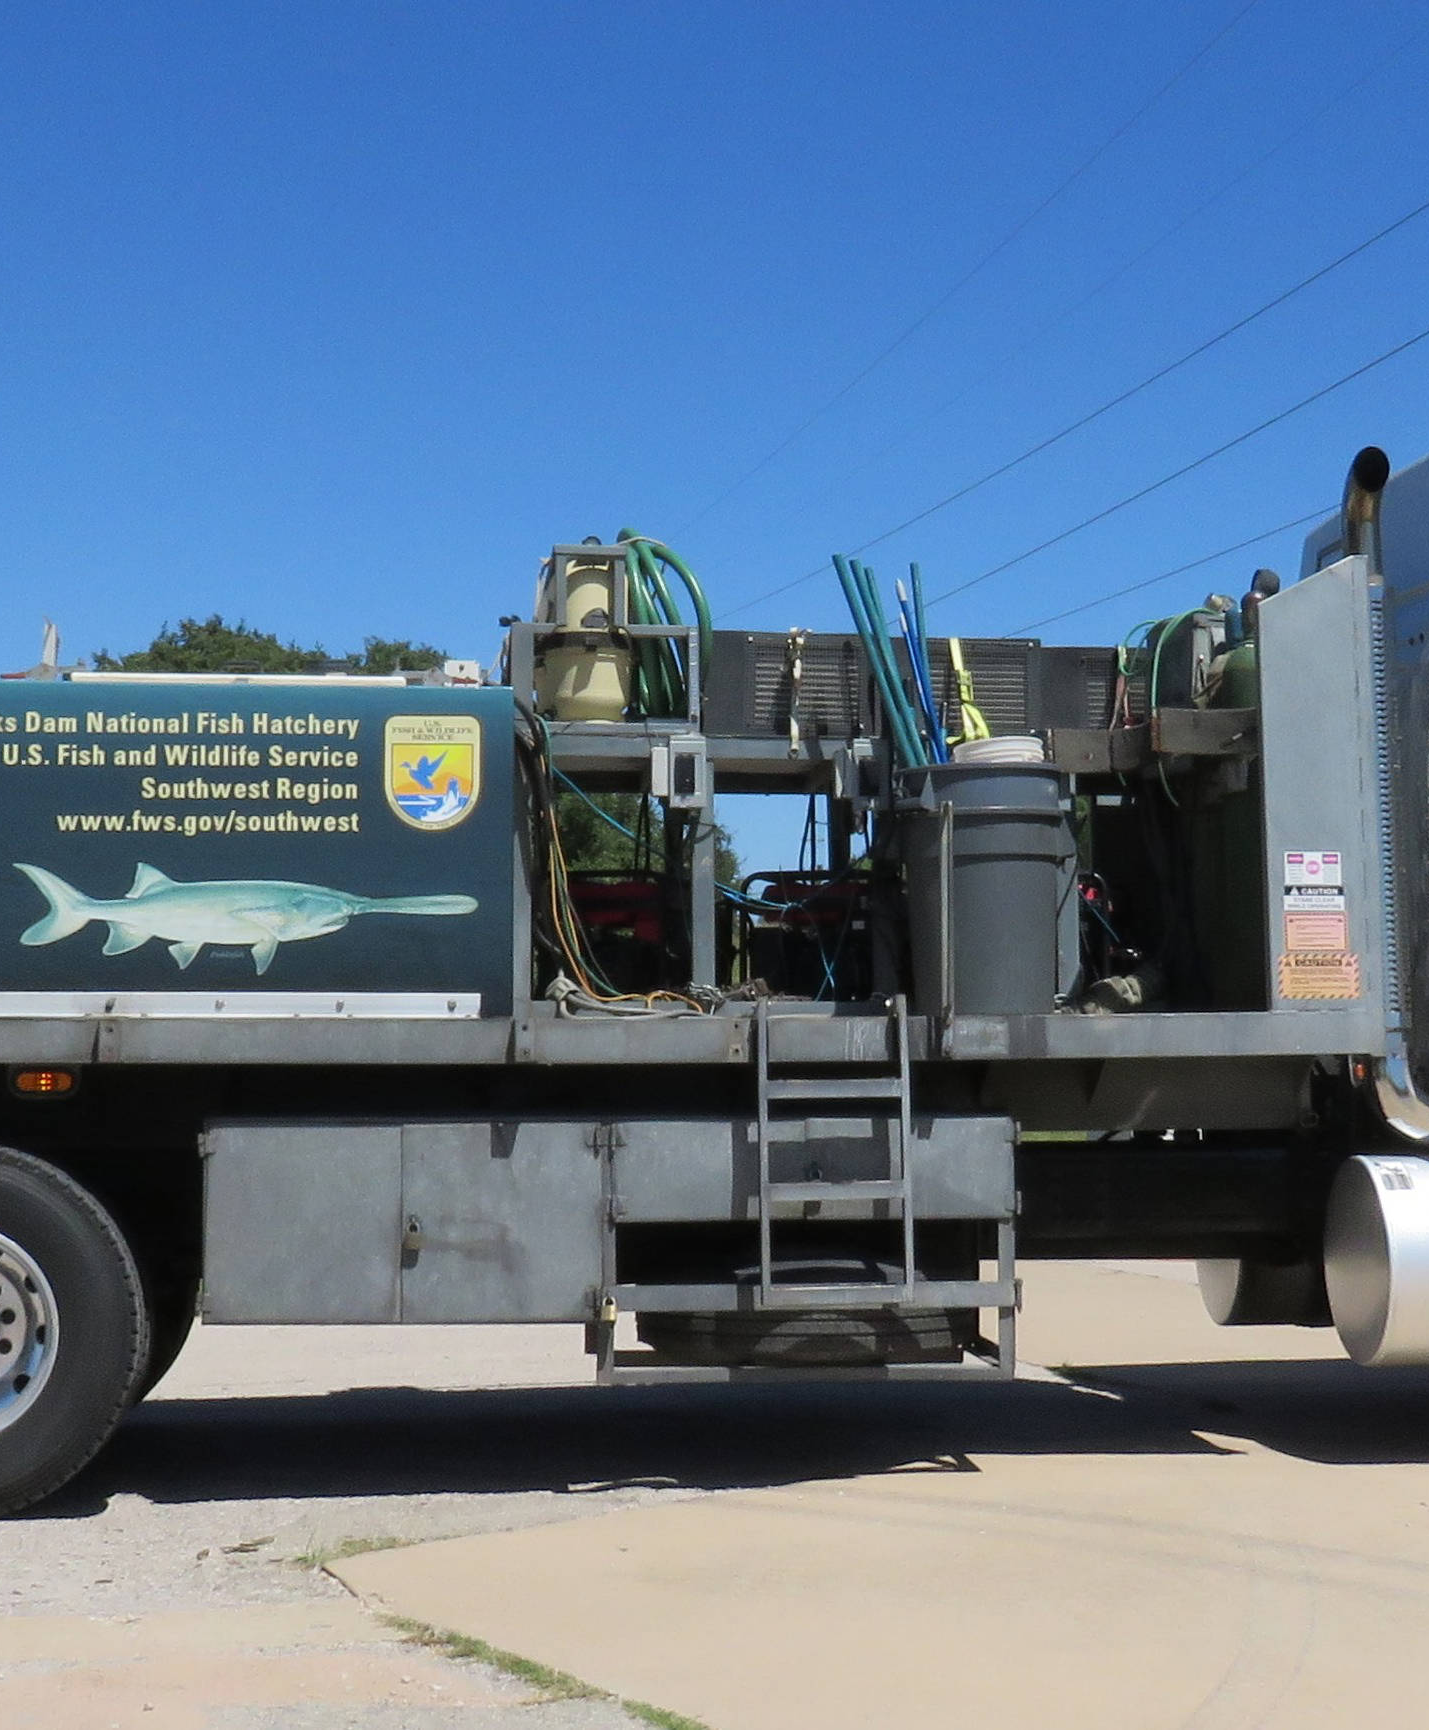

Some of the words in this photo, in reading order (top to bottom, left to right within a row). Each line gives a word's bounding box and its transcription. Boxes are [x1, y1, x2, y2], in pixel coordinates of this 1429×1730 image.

[25, 711, 77, 733] Dam
[86, 711, 189, 734] National
[197, 712, 244, 734] Fish
[252, 712, 360, 740] Hatchery
[3, 744, 50, 766] U.S.
[57, 744, 105, 766] Fish
[113, 744, 157, 766] and
[164, 744, 260, 767] Wildlife
[268, 744, 359, 767] Service
[141, 777, 270, 799] Southwest
[276, 777, 359, 804] Region
[57, 809, 360, 836] www.fws.gov/southwest
[1300, 887, 1339, 895] CAUTION
